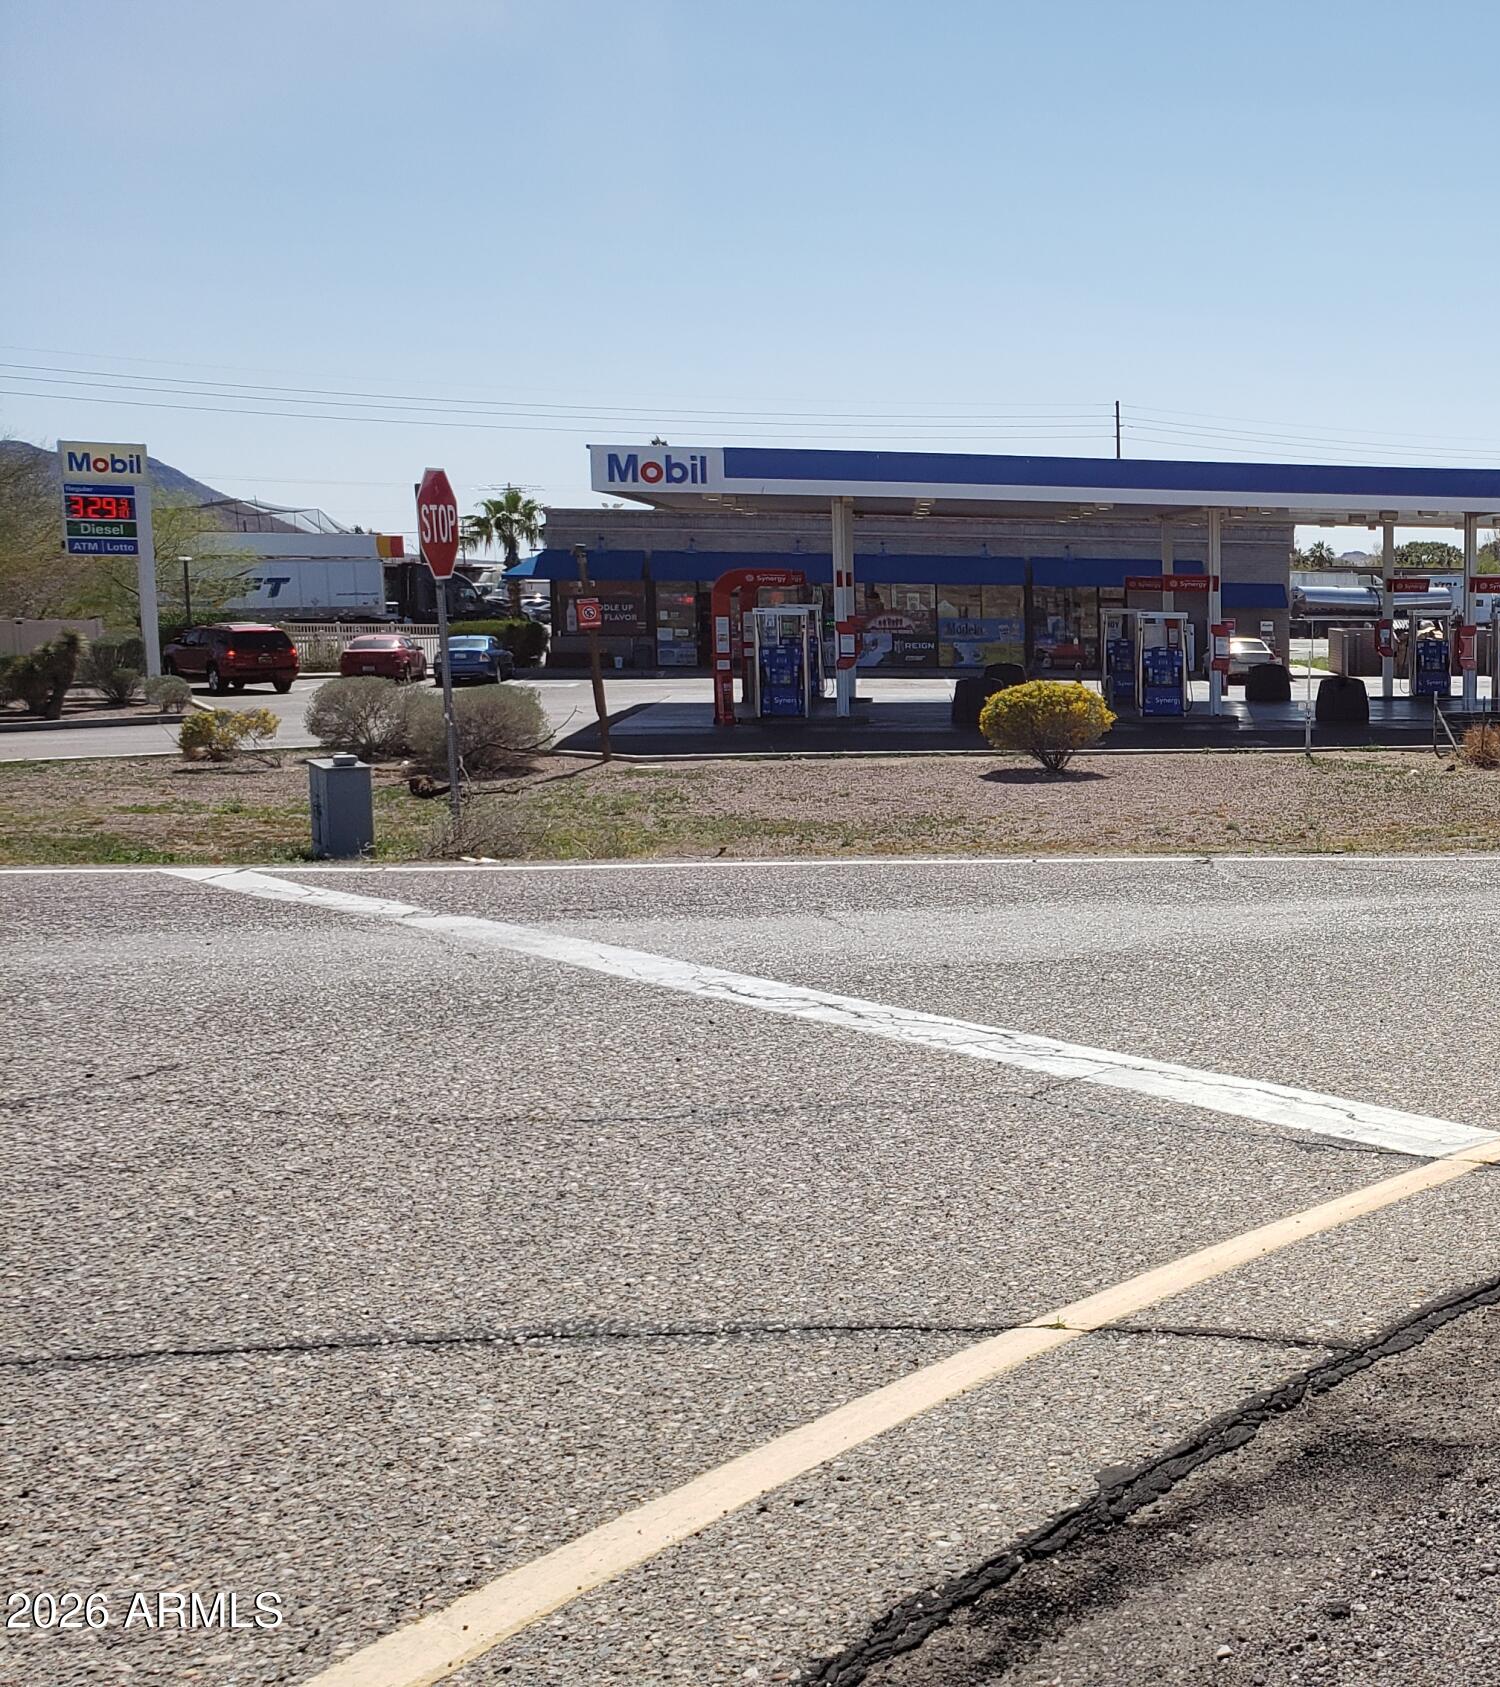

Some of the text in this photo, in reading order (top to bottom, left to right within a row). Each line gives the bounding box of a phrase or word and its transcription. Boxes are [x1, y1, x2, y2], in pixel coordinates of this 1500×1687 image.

[67, 451, 142, 474] Mobil
[608, 453, 708, 485] Mobil
[80, 523, 124, 535] Diesel
[421, 503, 456, 544] STOP
[73, 542, 135, 552] ATM Lotto
[756, 575, 786, 583] Synergy
[1180, 580, 1207, 588] Synergy
[604, 613, 638, 621] FLAVOR
